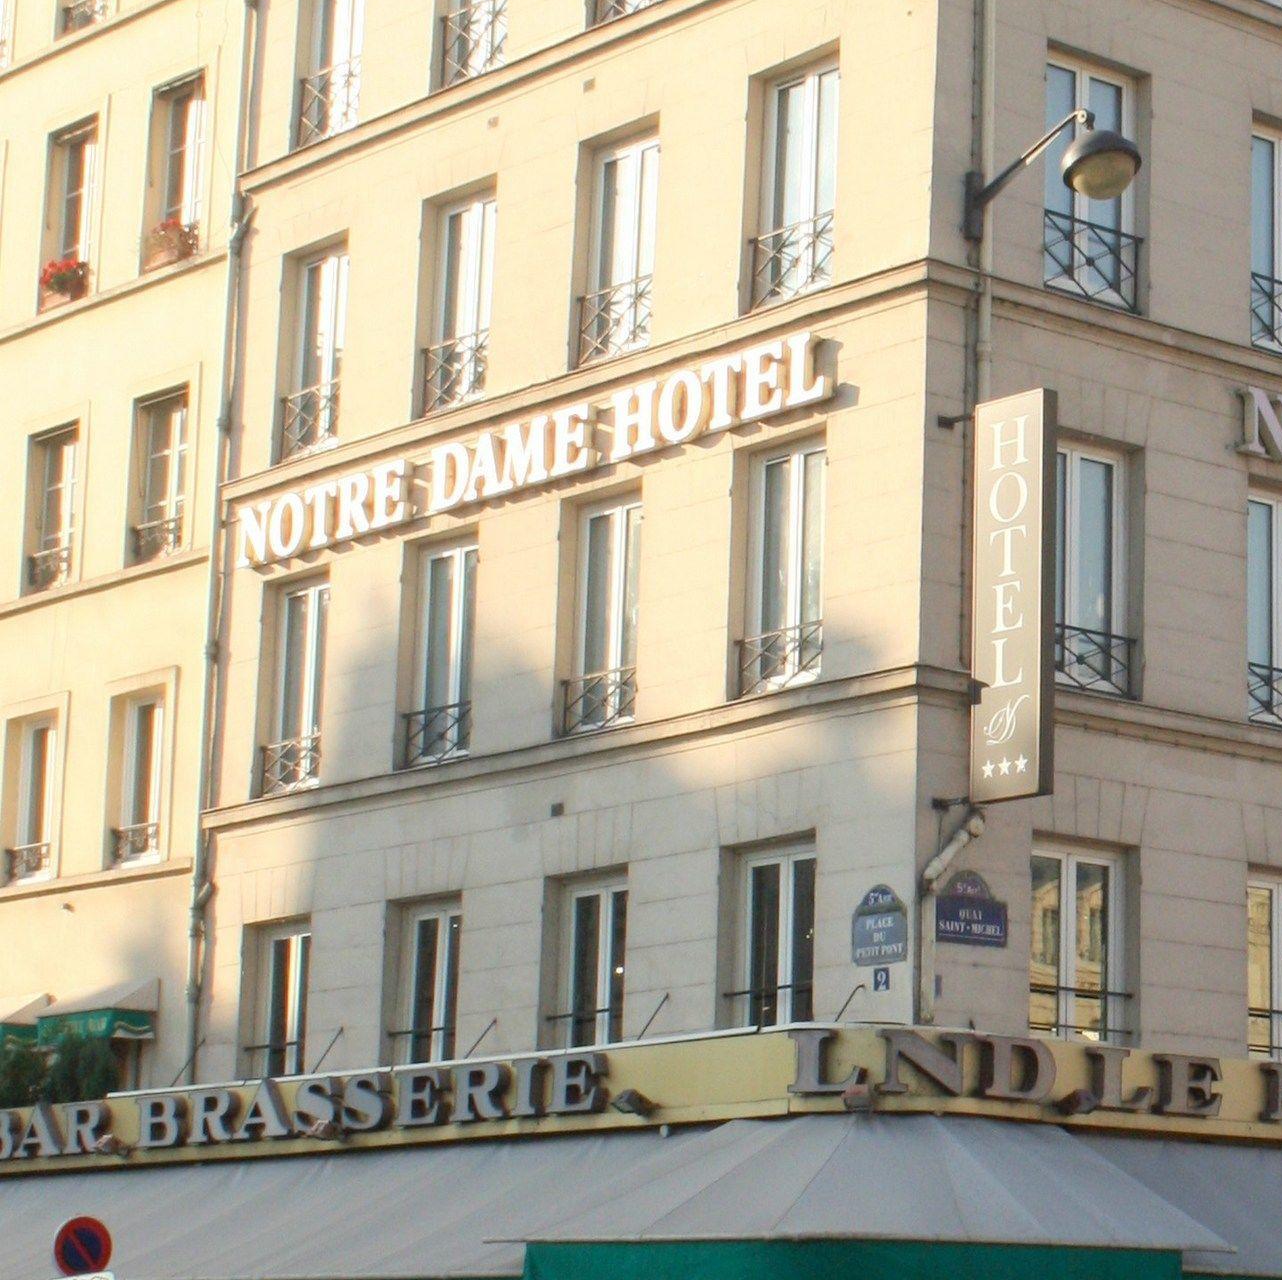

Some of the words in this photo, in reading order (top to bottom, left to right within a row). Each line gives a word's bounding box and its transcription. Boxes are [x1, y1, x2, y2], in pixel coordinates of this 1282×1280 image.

[236, 458, 408, 568] NOTRE
[427, 404, 594, 512] DAME
[611, 331, 825, 463] HOTEL
[987, 414, 1030, 690] HOTEL
[865, 916, 895, 930] PLACE
[958, 909, 982, 921] QUAI
[873, 932, 886, 943] DU
[856, 945, 880, 959] PETIT
[881, 943, 904, 956] PONT
[876, 971, 887, 991] 2
[1084, 1045, 1223, 1117] LE
[136, 1051, 604, 1149] BRASSERIE
